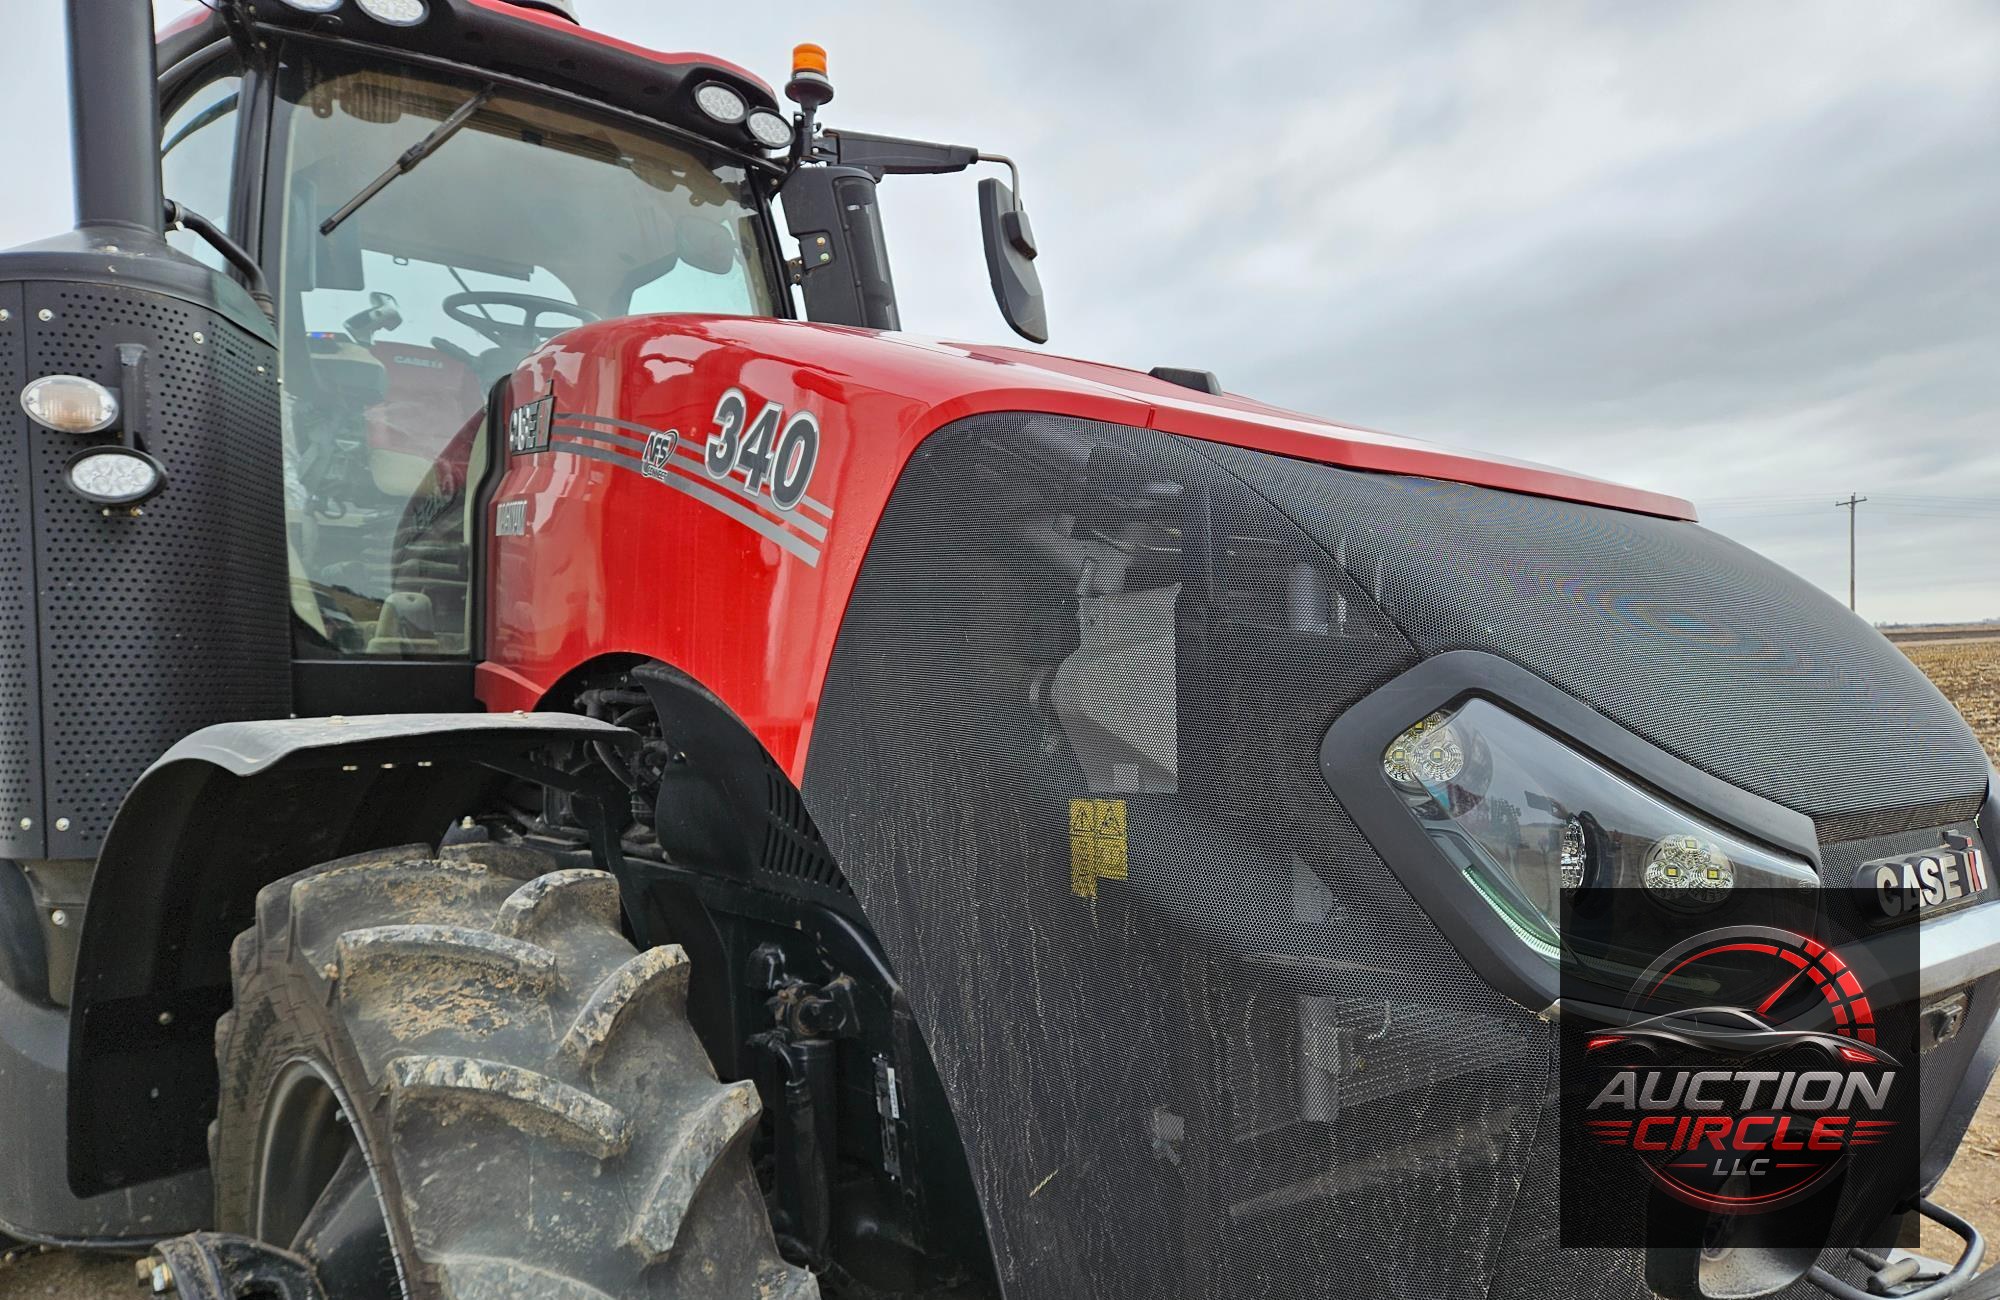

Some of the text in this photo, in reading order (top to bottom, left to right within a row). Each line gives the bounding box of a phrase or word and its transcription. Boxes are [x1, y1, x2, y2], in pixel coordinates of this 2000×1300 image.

[642, 431, 671, 467] AFS
[704, 387, 820, 512] 340
[1876, 853, 1962, 917] CASE
